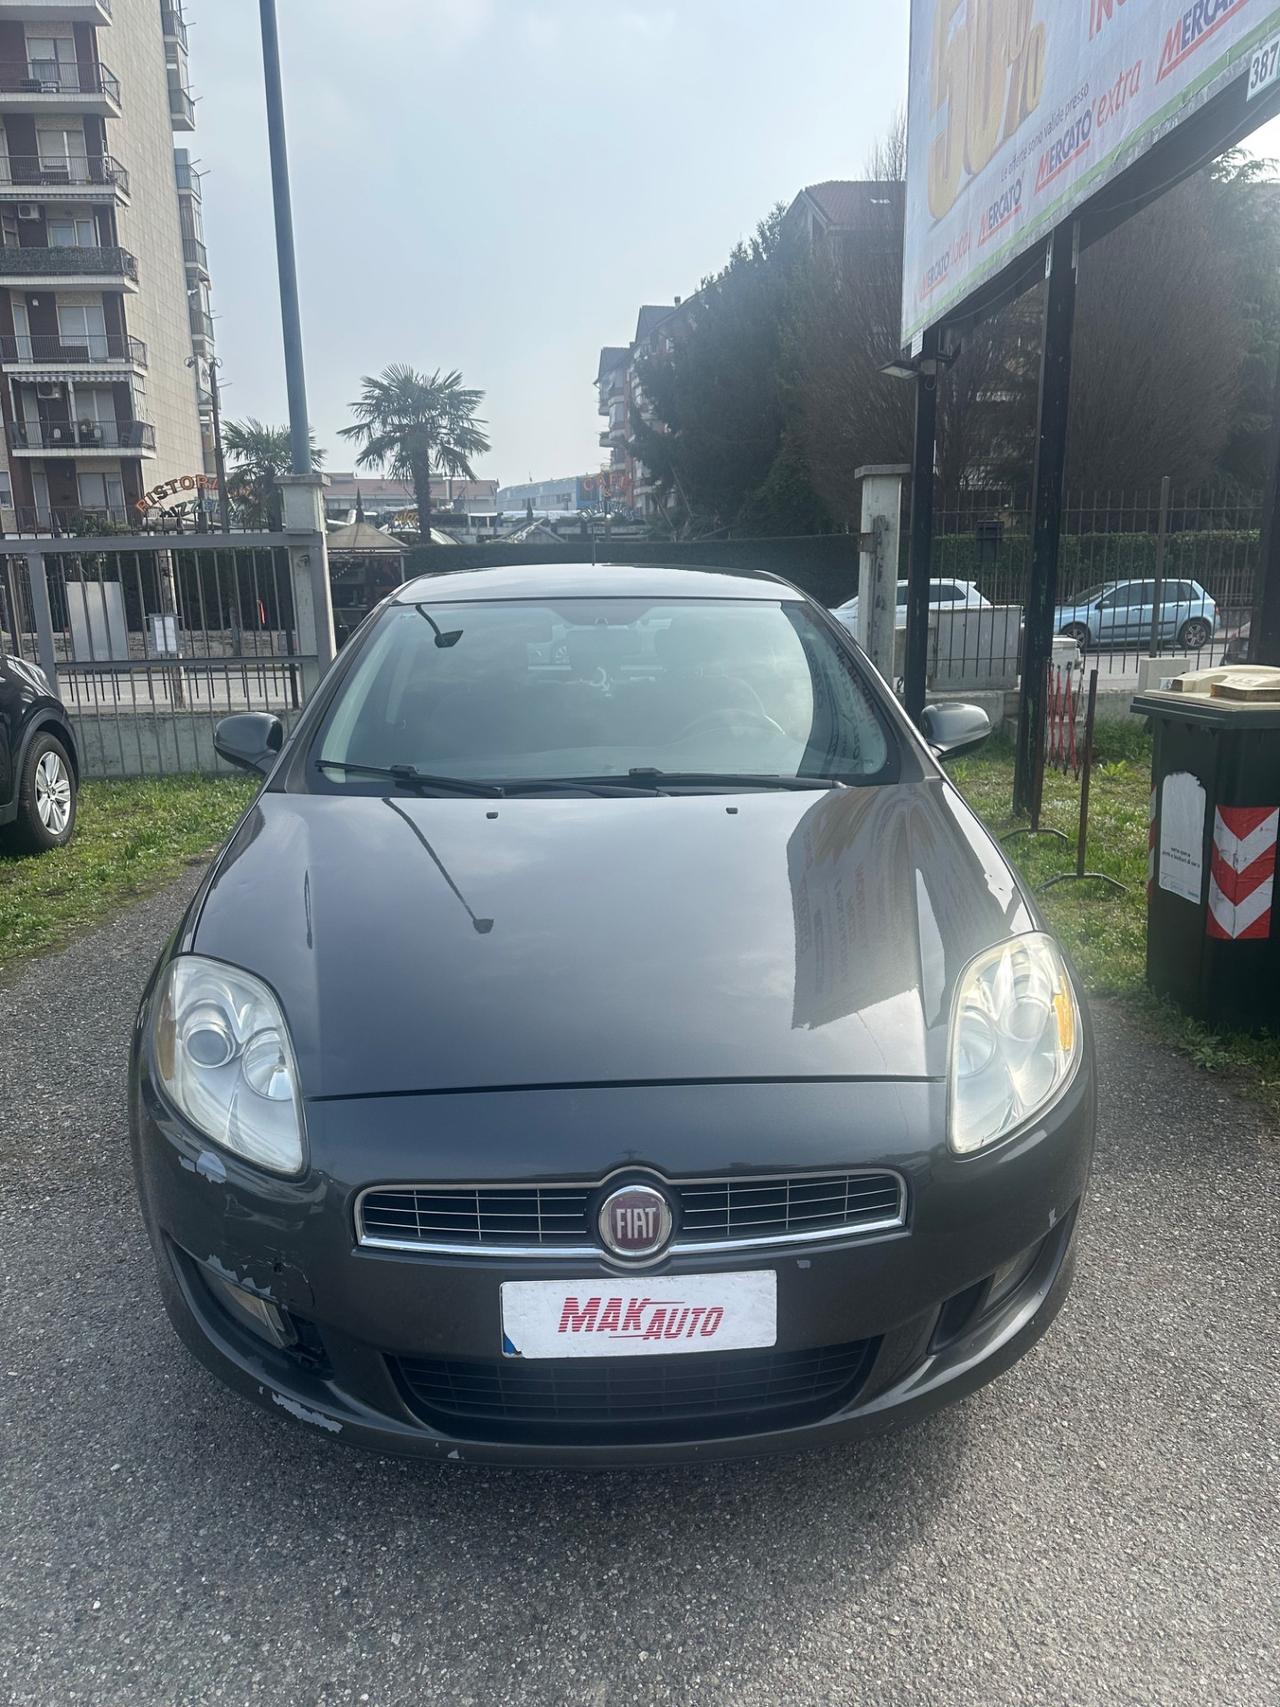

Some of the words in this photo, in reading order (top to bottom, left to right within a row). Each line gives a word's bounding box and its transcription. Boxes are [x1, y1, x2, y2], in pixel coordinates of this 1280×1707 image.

[1250, 41, 1280, 90] 387
[1097, 60, 1142, 128] extra
[616, 1207, 657, 1239] FIAT
[558, 1297, 651, 1334] MAK
[642, 1306, 724, 1341] AUTO
